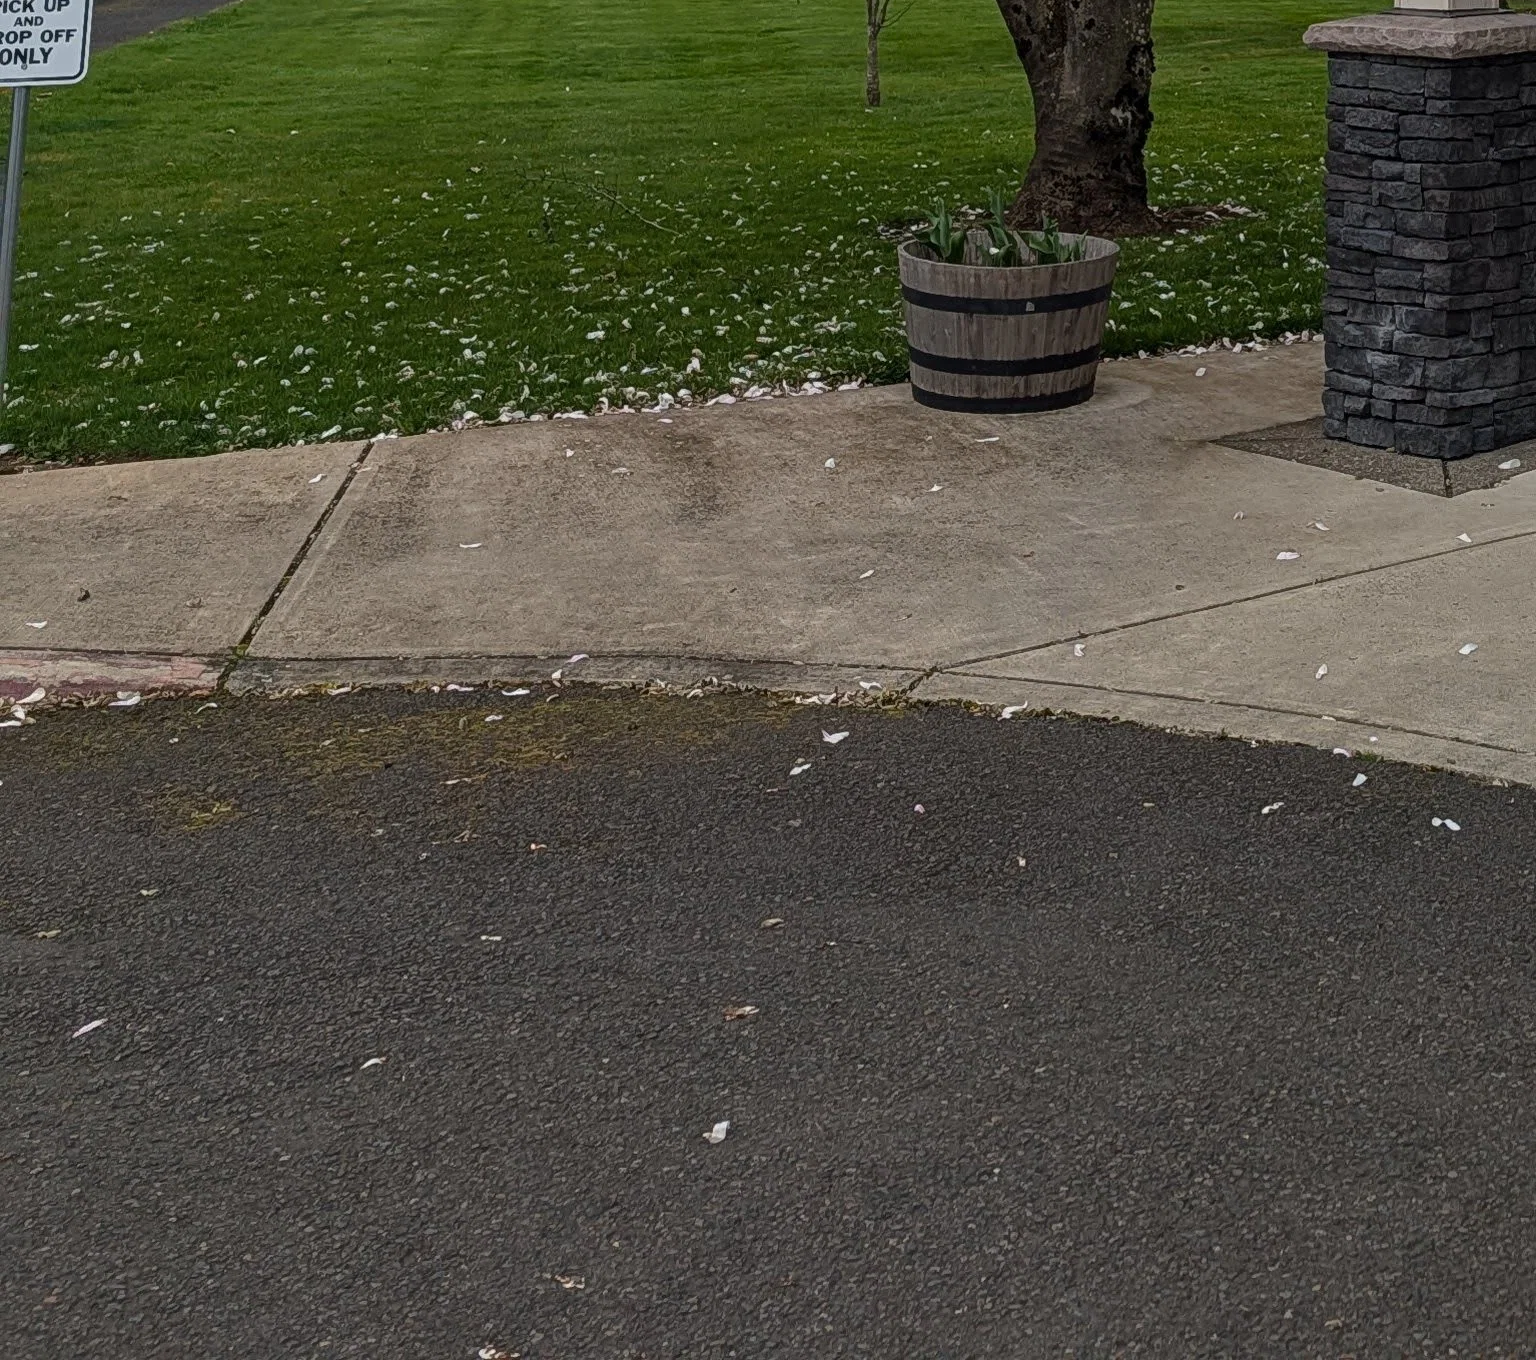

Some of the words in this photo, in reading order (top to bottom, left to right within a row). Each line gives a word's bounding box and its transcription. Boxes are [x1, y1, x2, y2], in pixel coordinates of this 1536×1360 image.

[0, 0, 35, 13] ICK
[13, 16, 44, 27] AND
[40, 29, 77, 43] OFF
[0, 47, 53, 65] ONLY
